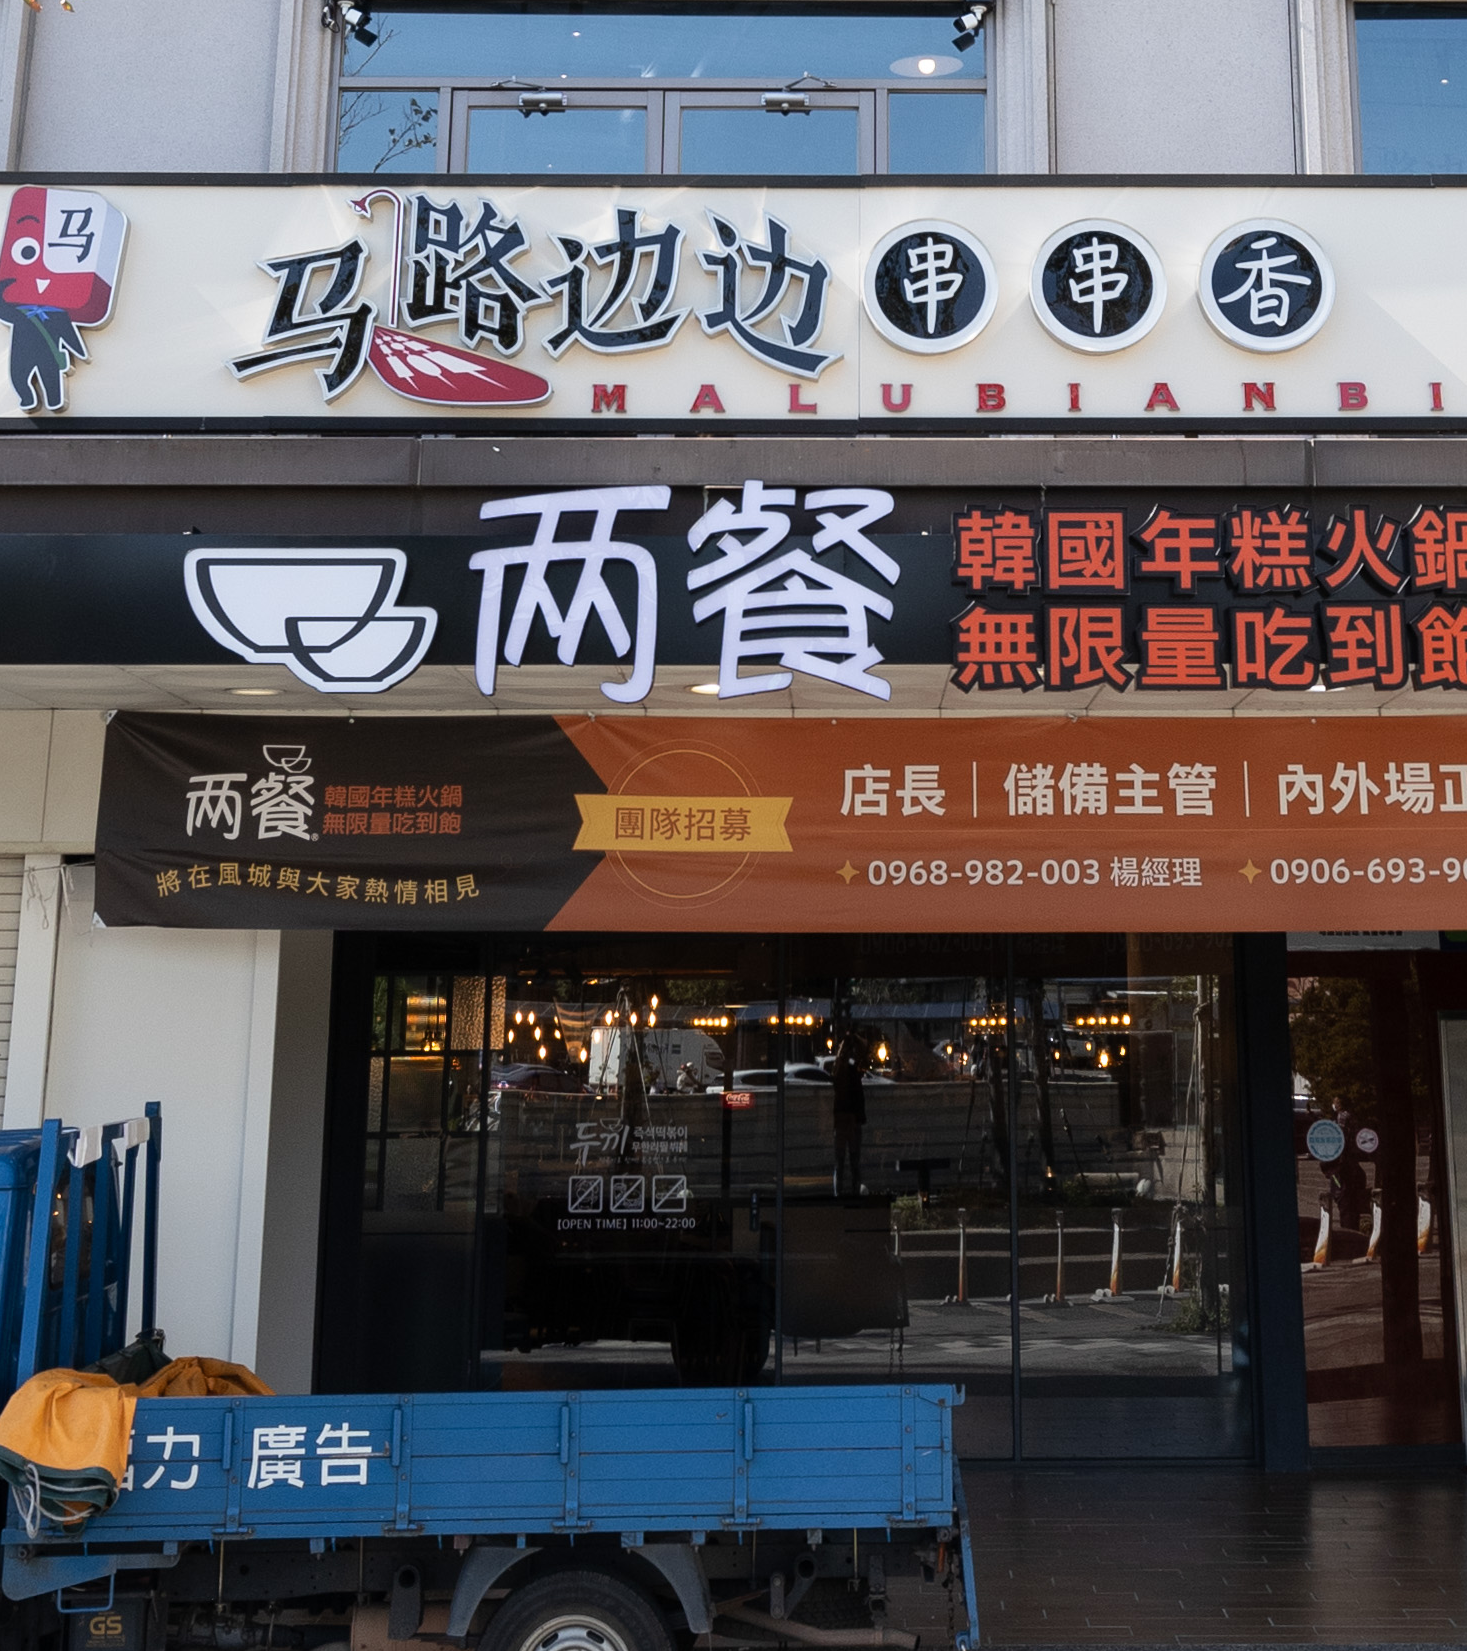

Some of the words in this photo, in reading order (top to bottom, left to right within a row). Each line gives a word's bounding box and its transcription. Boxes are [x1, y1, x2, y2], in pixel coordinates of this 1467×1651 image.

[56, 207, 95, 262] 马
[226, 194, 845, 405] 马路边边
[891, 230, 1318, 343] 串串香
[469, 479, 901, 703] 两餐
[324, 785, 464, 810] 韓國年糕火鍋
[839, 763, 946, 818] 店長
[1003, 762, 1217, 818] 儲備主管
[322, 810, 462, 835] 無限量吃到飽
[613, 807, 753, 842] 團隊招募
[156, 861, 481, 906] 將在風城與大家熱情相見
[867, 858, 1101, 887] 0968-982-003
[1110, 855, 1203, 889] 楊經理
[247, 1423, 373, 1489] 廣告
[89, 1615, 123, 1636] GS
